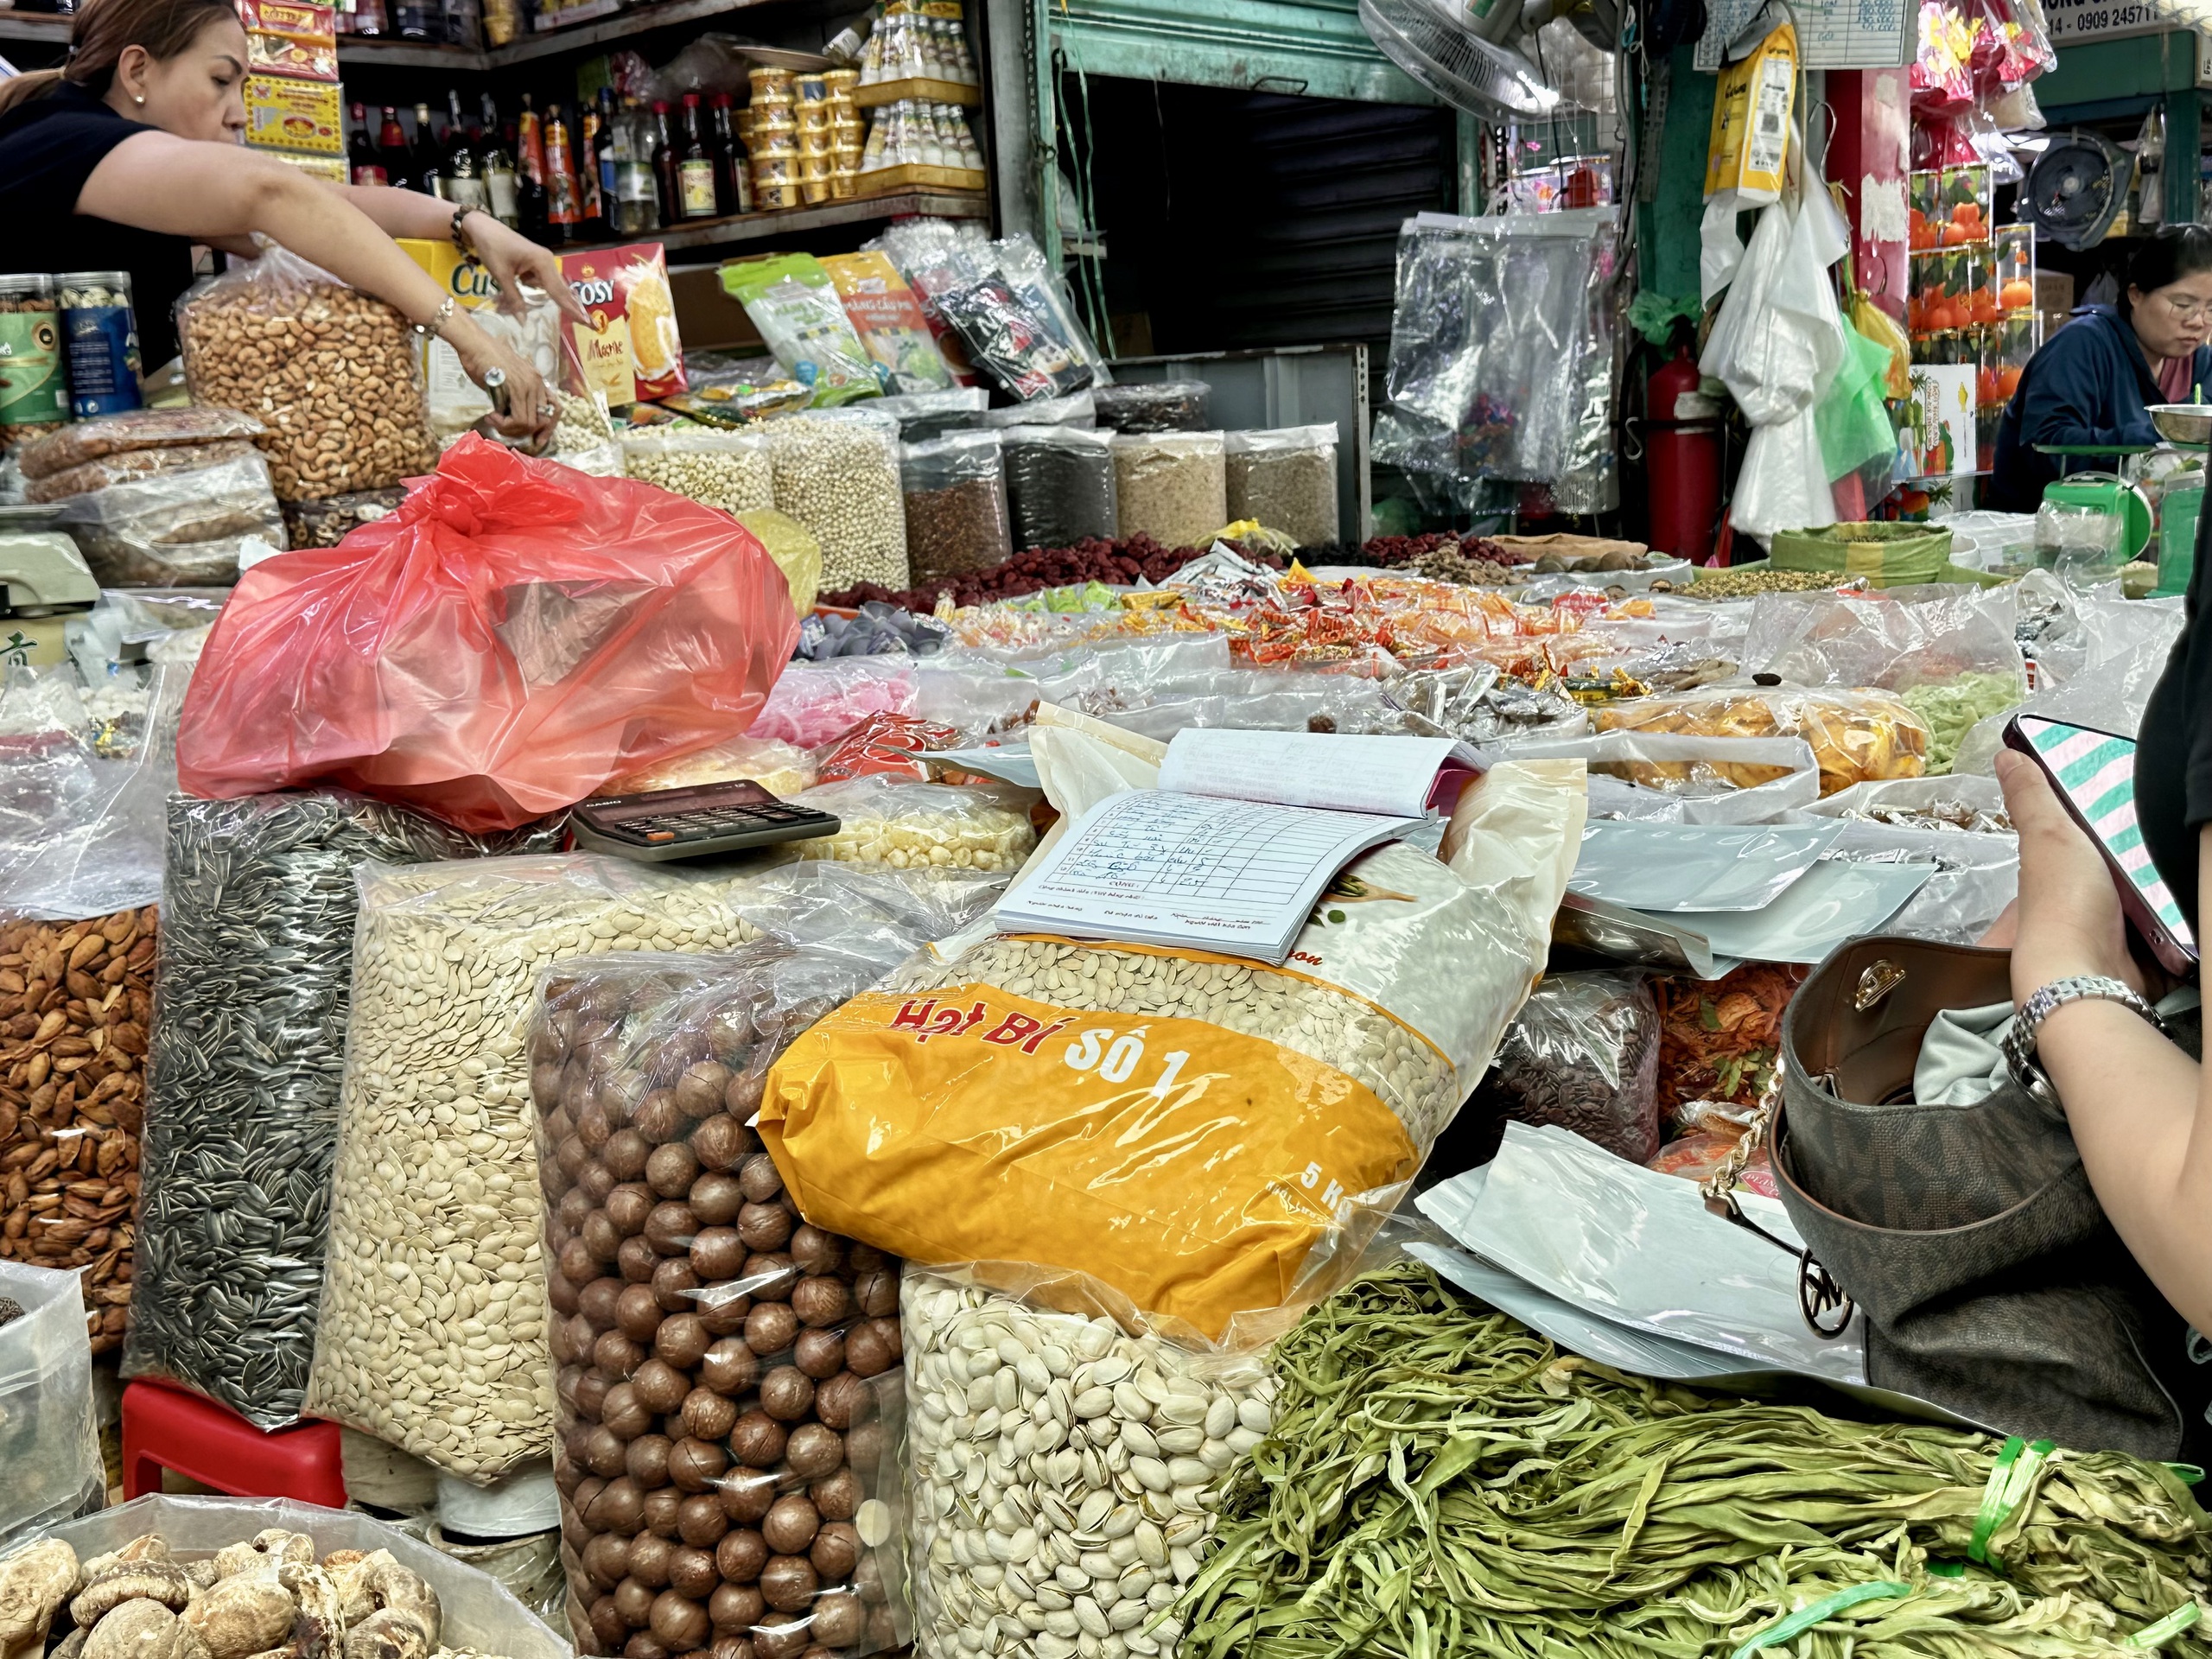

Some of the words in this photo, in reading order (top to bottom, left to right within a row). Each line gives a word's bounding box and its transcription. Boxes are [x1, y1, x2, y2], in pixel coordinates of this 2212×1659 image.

[2077, 10, 2108, 32] 0909
[1064, 1024, 1154, 1084] SỐ
[1149, 1049, 1191, 1099] 1
[1300, 1160, 1323, 1189] 5
